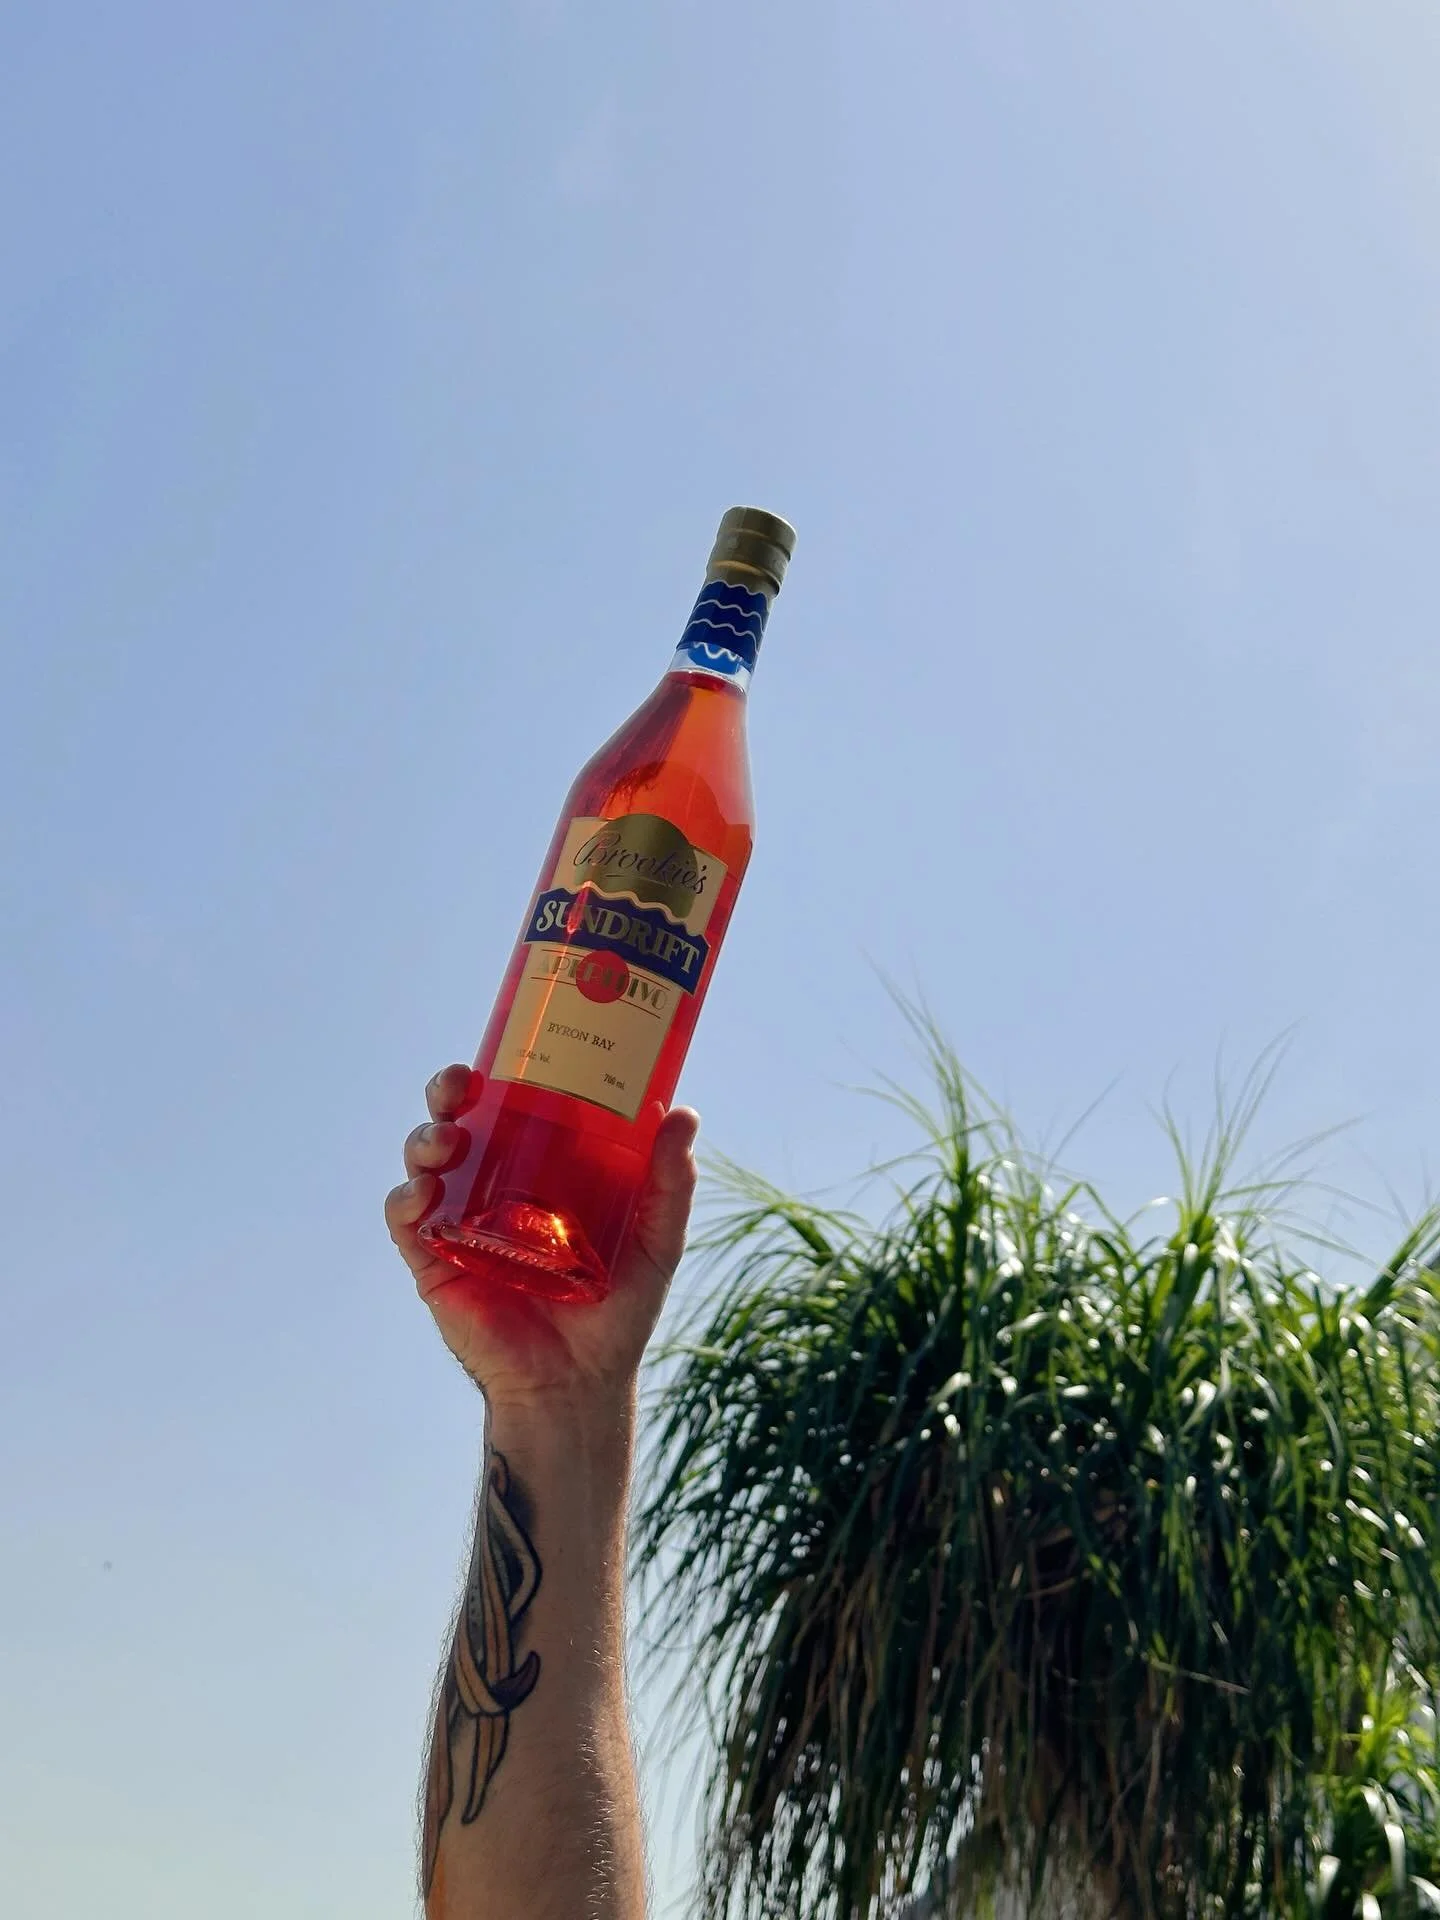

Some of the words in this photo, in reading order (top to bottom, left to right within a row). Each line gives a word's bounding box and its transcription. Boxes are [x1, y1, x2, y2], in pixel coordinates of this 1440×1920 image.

[573, 831, 706, 895] Brookie's
[536, 900, 700, 974] SUNDRIFT
[546, 1022, 590, 1042] BYRON
[592, 1034, 616, 1051] BAY
